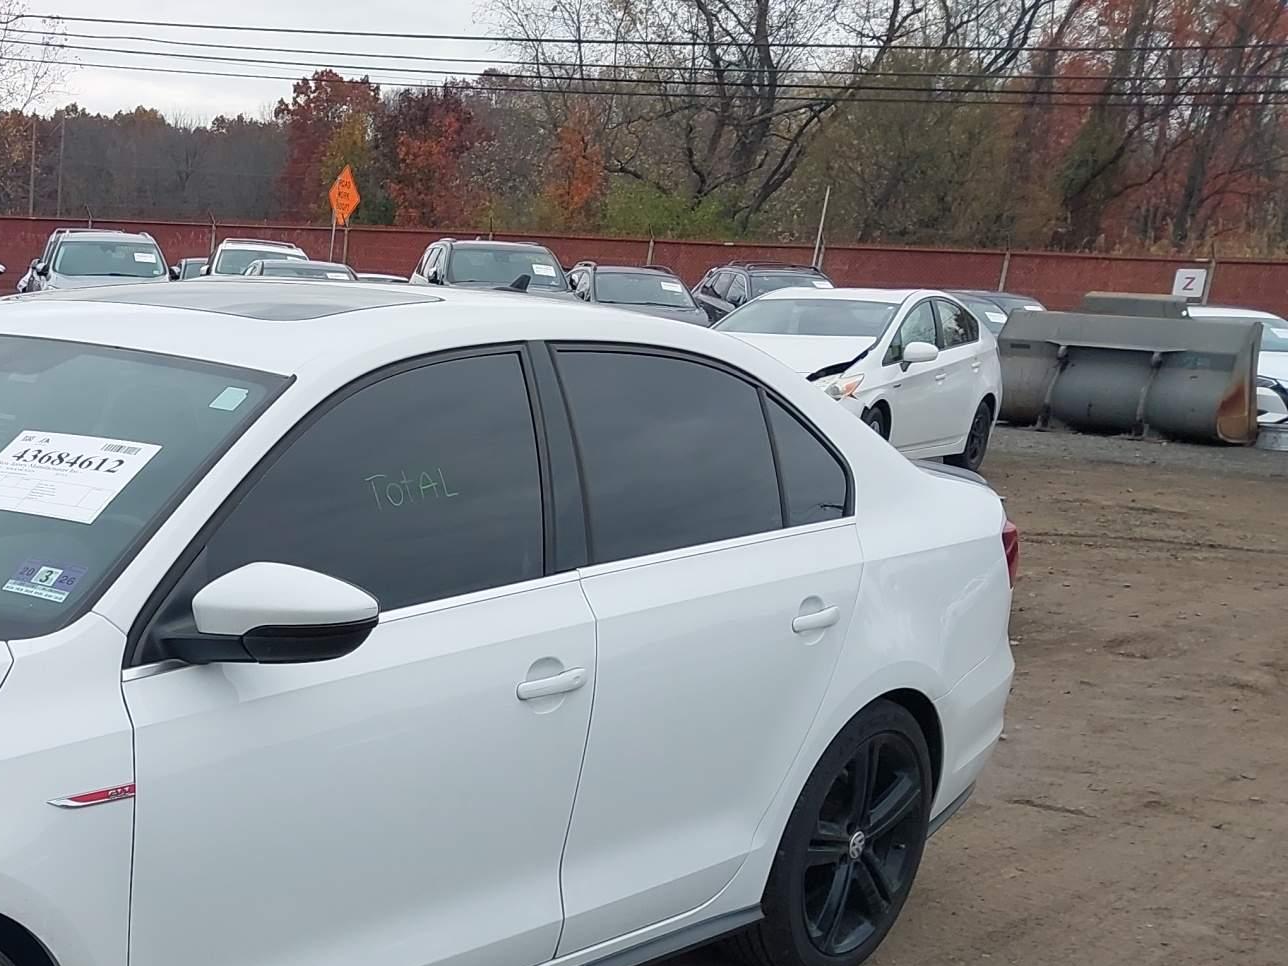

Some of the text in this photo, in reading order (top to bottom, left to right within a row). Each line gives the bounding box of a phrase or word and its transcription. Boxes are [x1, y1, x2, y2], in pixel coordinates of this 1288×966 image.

[1182, 276, 1196, 291] Z
[11, 447, 126, 474] 43684612
[38, 570, 54, 583] 3
[59, 575, 76, 586] 26
